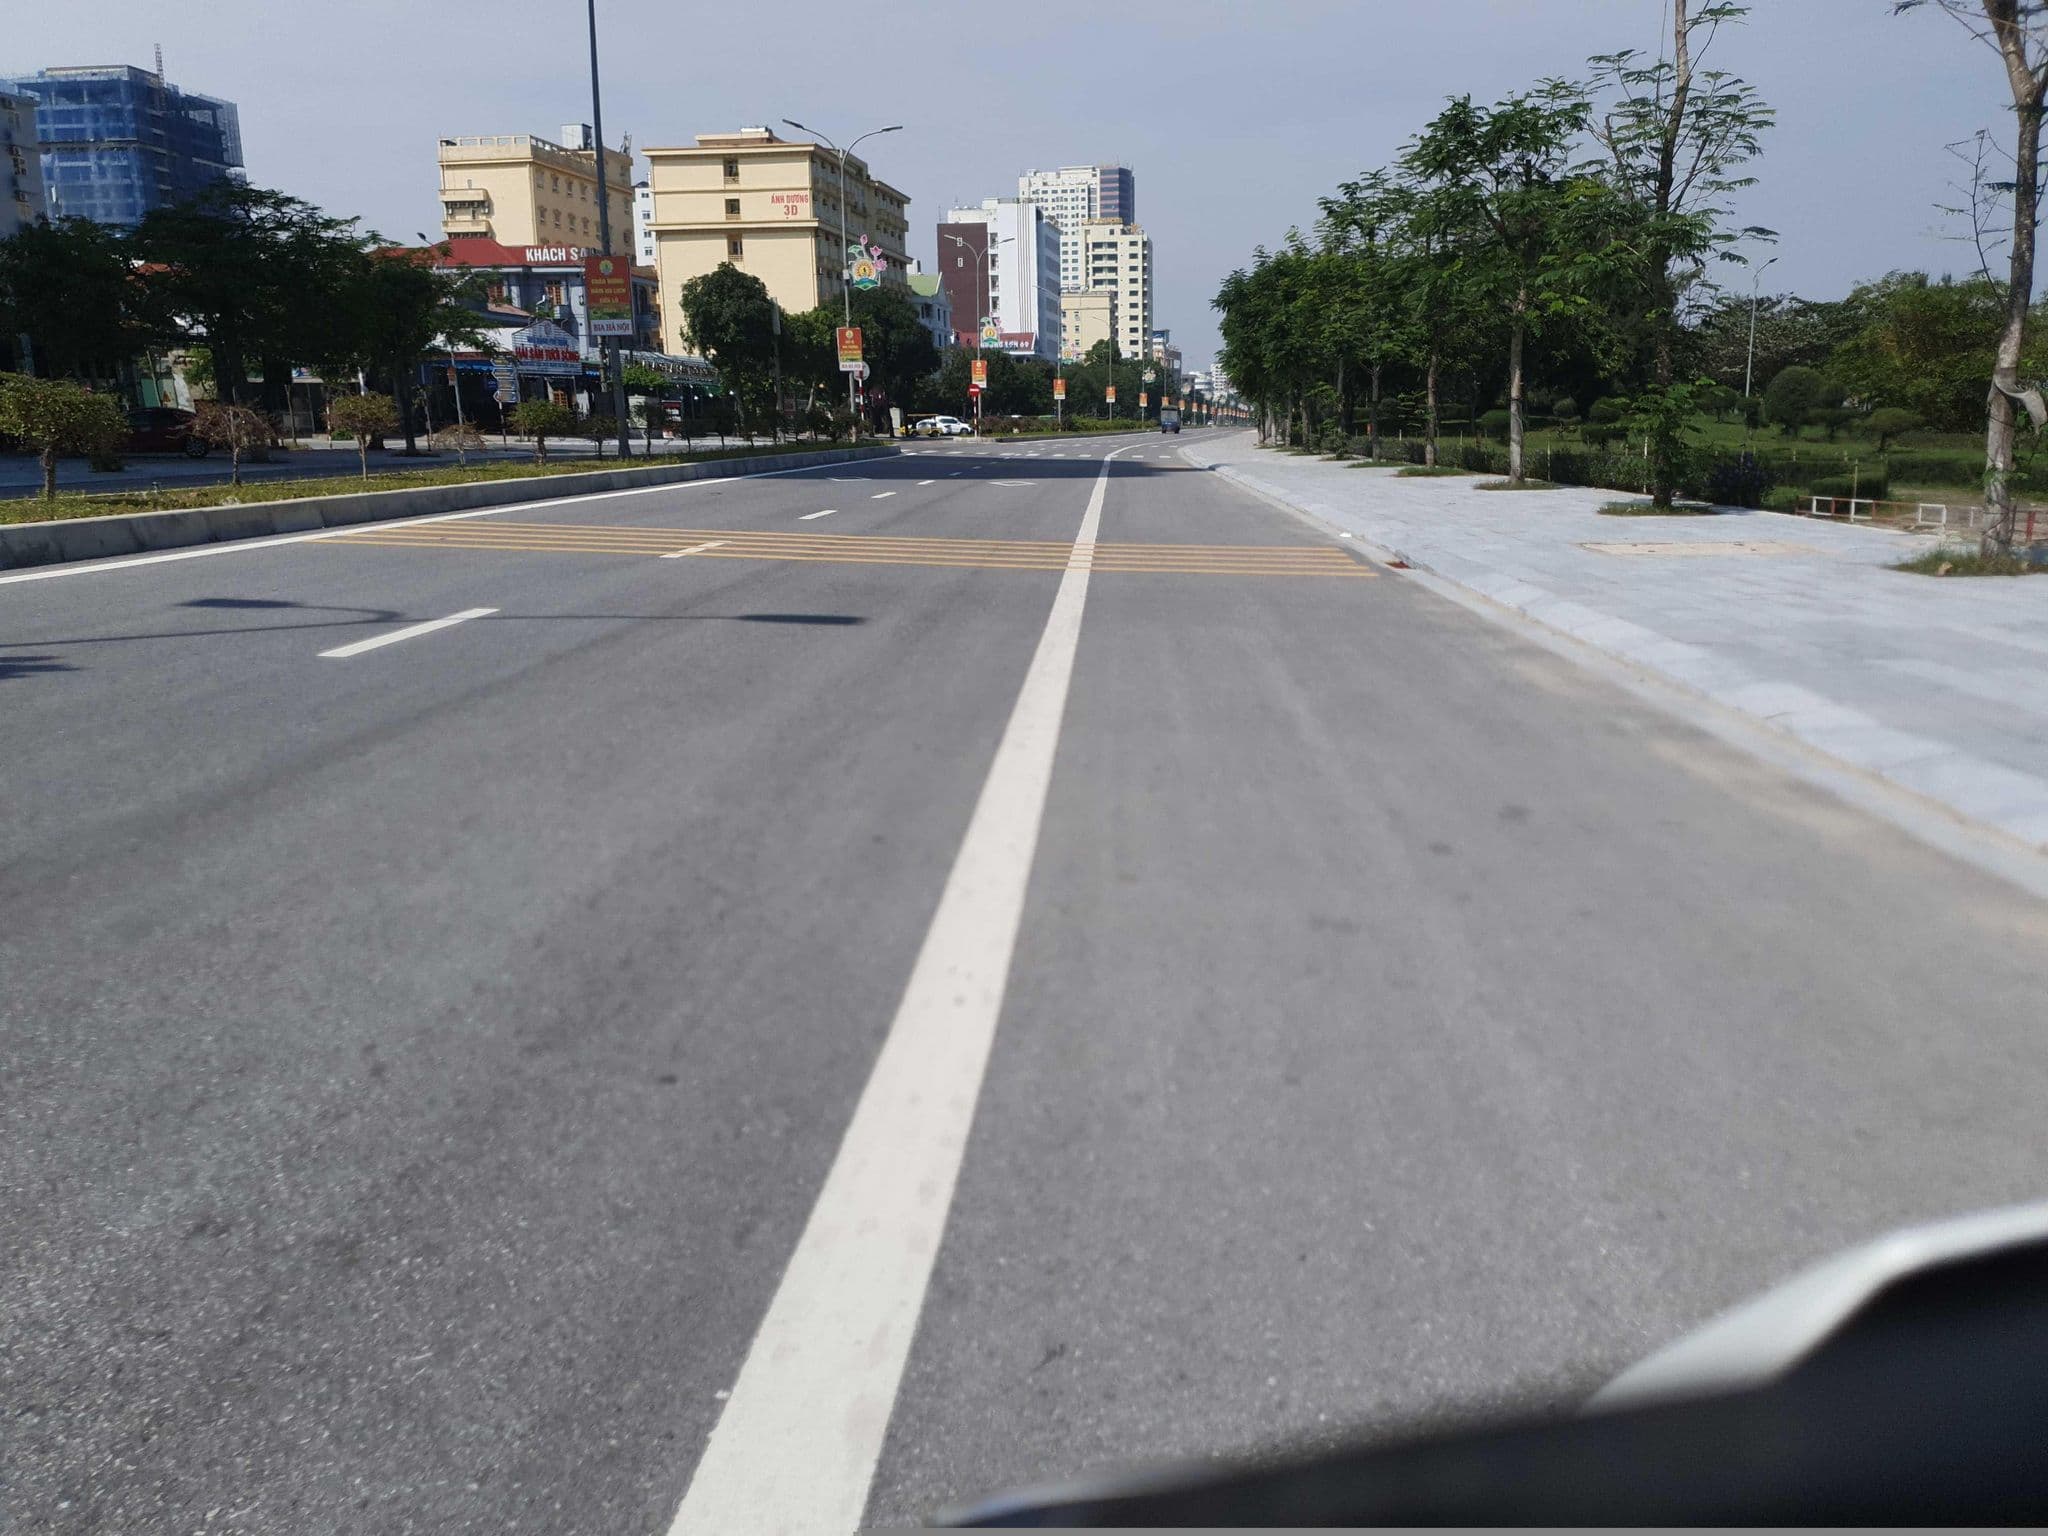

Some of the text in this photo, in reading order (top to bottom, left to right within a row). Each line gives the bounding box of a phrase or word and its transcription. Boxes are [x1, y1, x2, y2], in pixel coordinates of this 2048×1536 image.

[784, 204, 798, 216] 3D
[526, 245, 566, 262] KHÁCH
[593, 323, 605, 332] BIA
